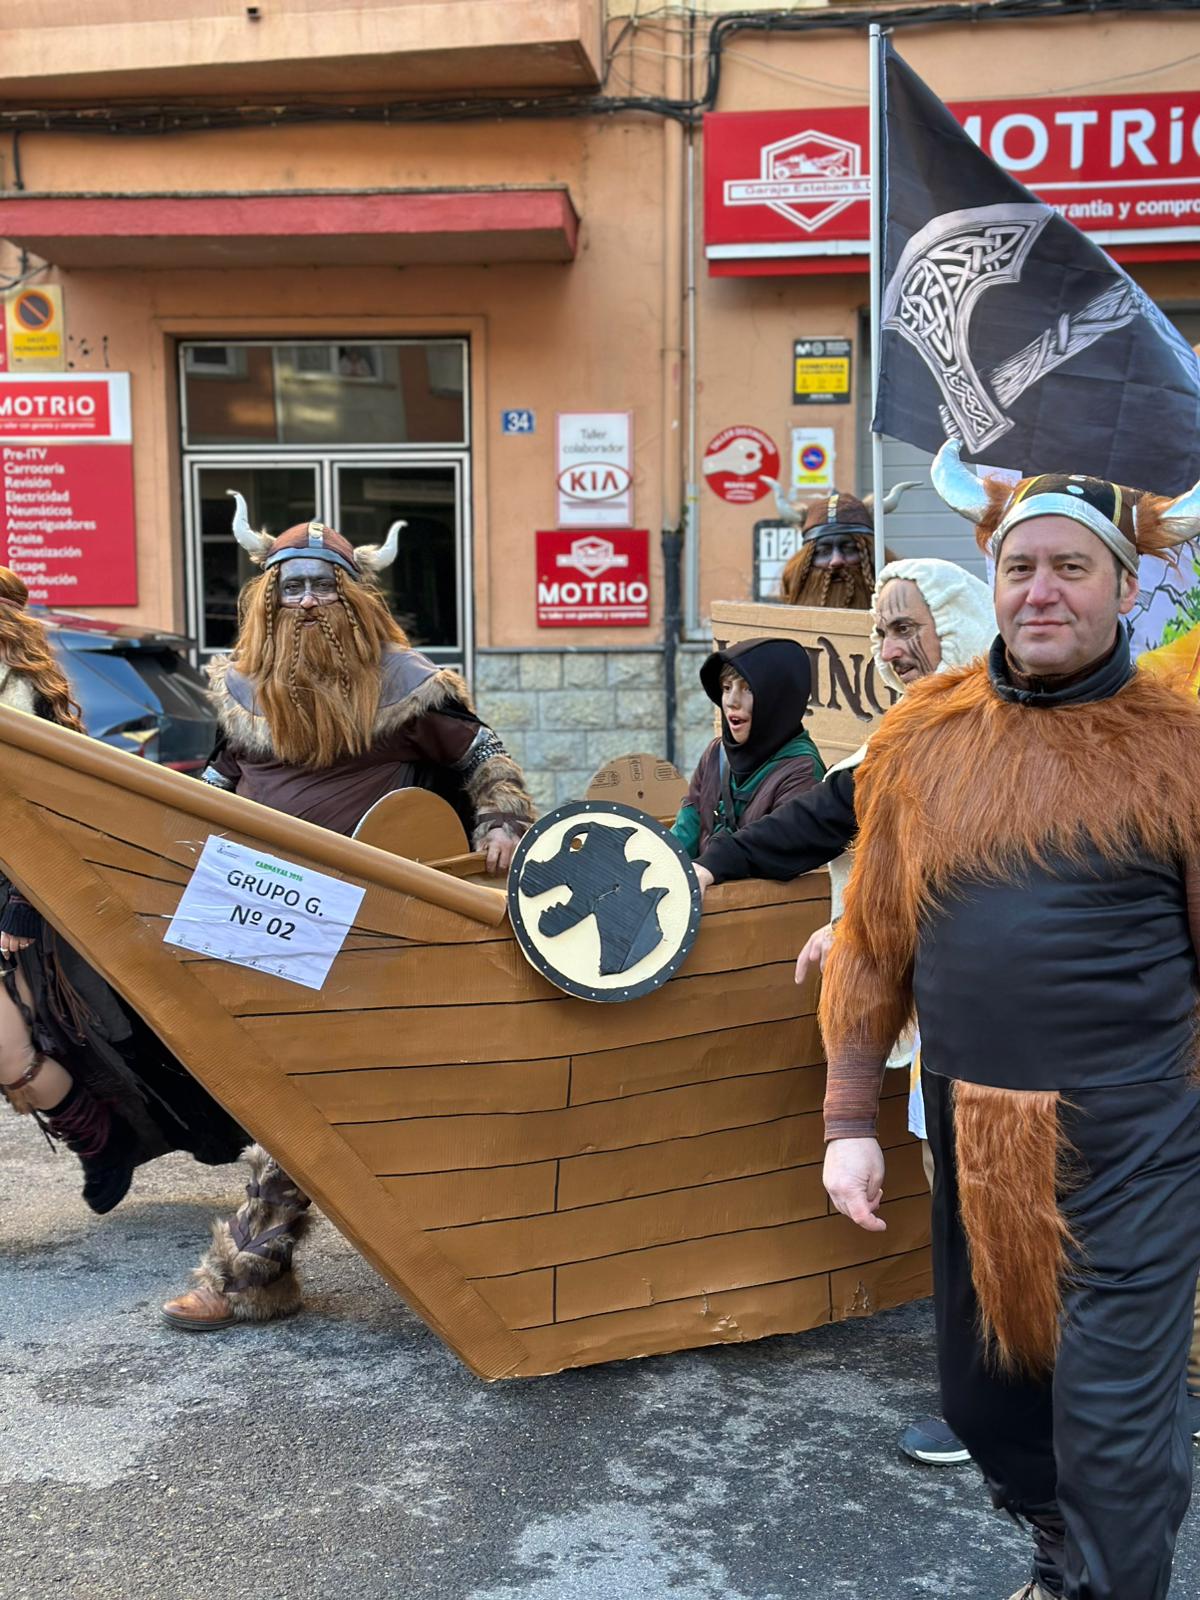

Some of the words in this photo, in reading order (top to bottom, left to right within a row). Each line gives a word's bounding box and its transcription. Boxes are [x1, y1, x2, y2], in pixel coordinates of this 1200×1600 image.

[963, 107, 1200, 171] OTRi
[745, 185, 790, 196] Garaje
[794, 182, 849, 193] Esteban
[1052, 200, 1114, 219] arantia
[1117, 202, 1131, 220] y
[508, 412, 529, 431] 34
[580, 428, 607, 440] Taller
[3, 447, 48, 460] Pre-ITV
[563, 442, 624, 454] colaborador
[570, 470, 620, 492] KIA
[5, 490, 70, 503] Electricidad
[7, 532, 44, 545] Aceite
[9, 559, 47, 573] Escape
[19, 573, 78, 586] stribución
[255, 860, 288, 878] CARNAVAL
[227, 869, 300, 907] GRUPO
[305, 897, 324, 917] G.
[229, 904, 262, 926] Nº
[266, 917, 296, 941] 02
